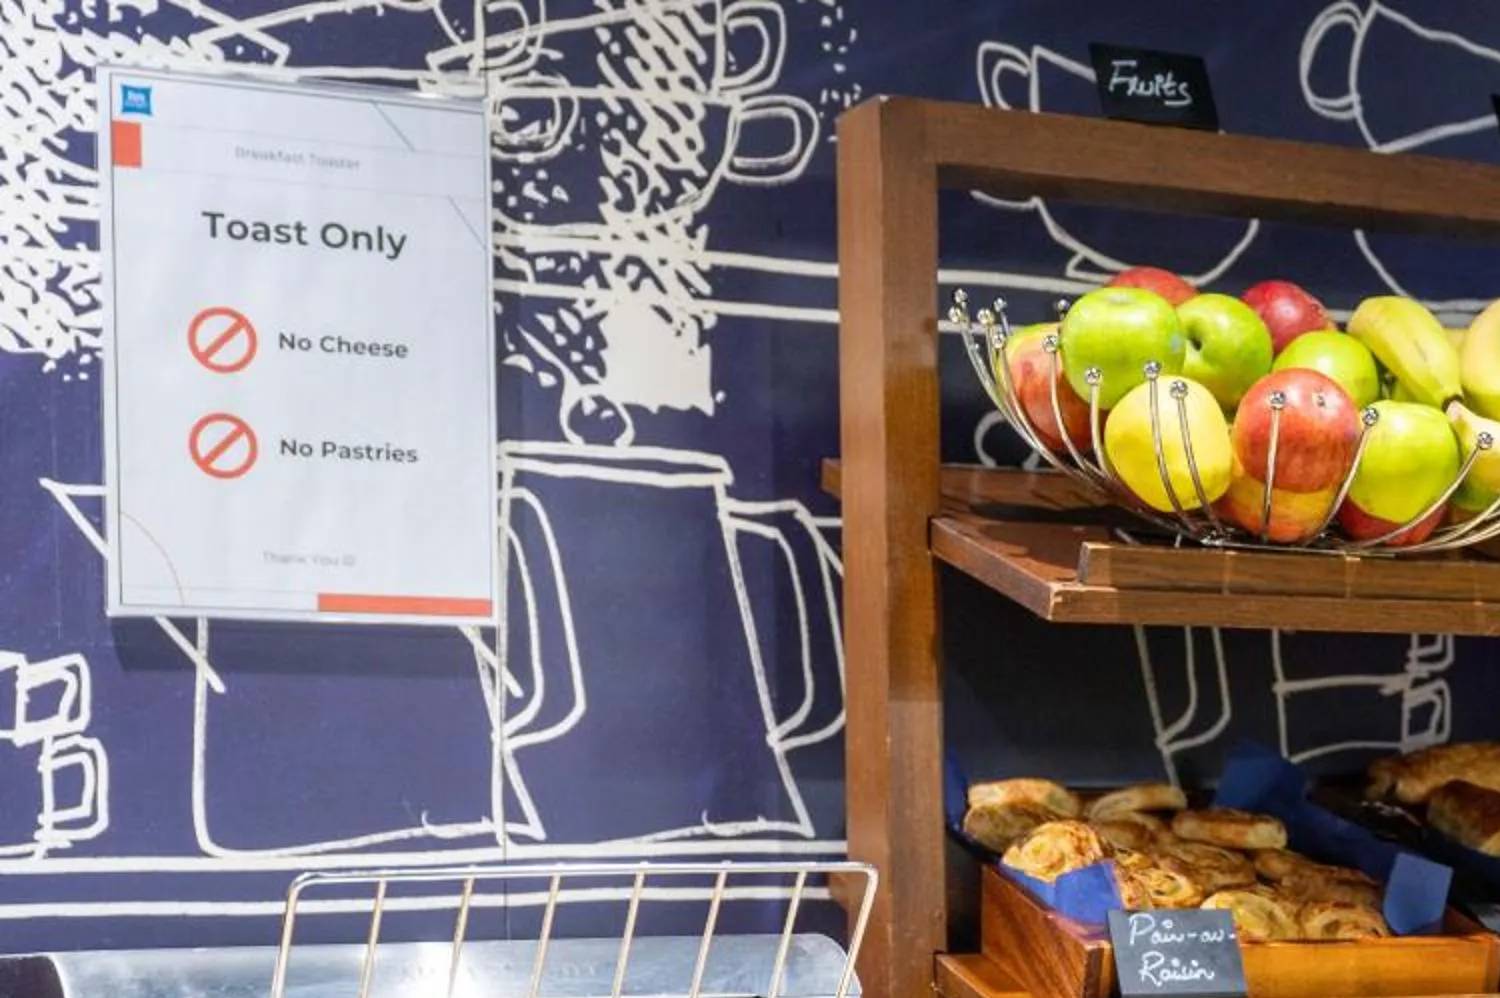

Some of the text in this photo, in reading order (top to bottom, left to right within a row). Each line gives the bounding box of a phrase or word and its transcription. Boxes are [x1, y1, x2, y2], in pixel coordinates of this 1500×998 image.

[1108, 59, 1193, 107] Fruits
[201, 211, 407, 260] Toast Only
[279, 332, 408, 359] No Cheese
[280, 439, 418, 463] No Pastries
[1138, 950, 1215, 987] Raisin
